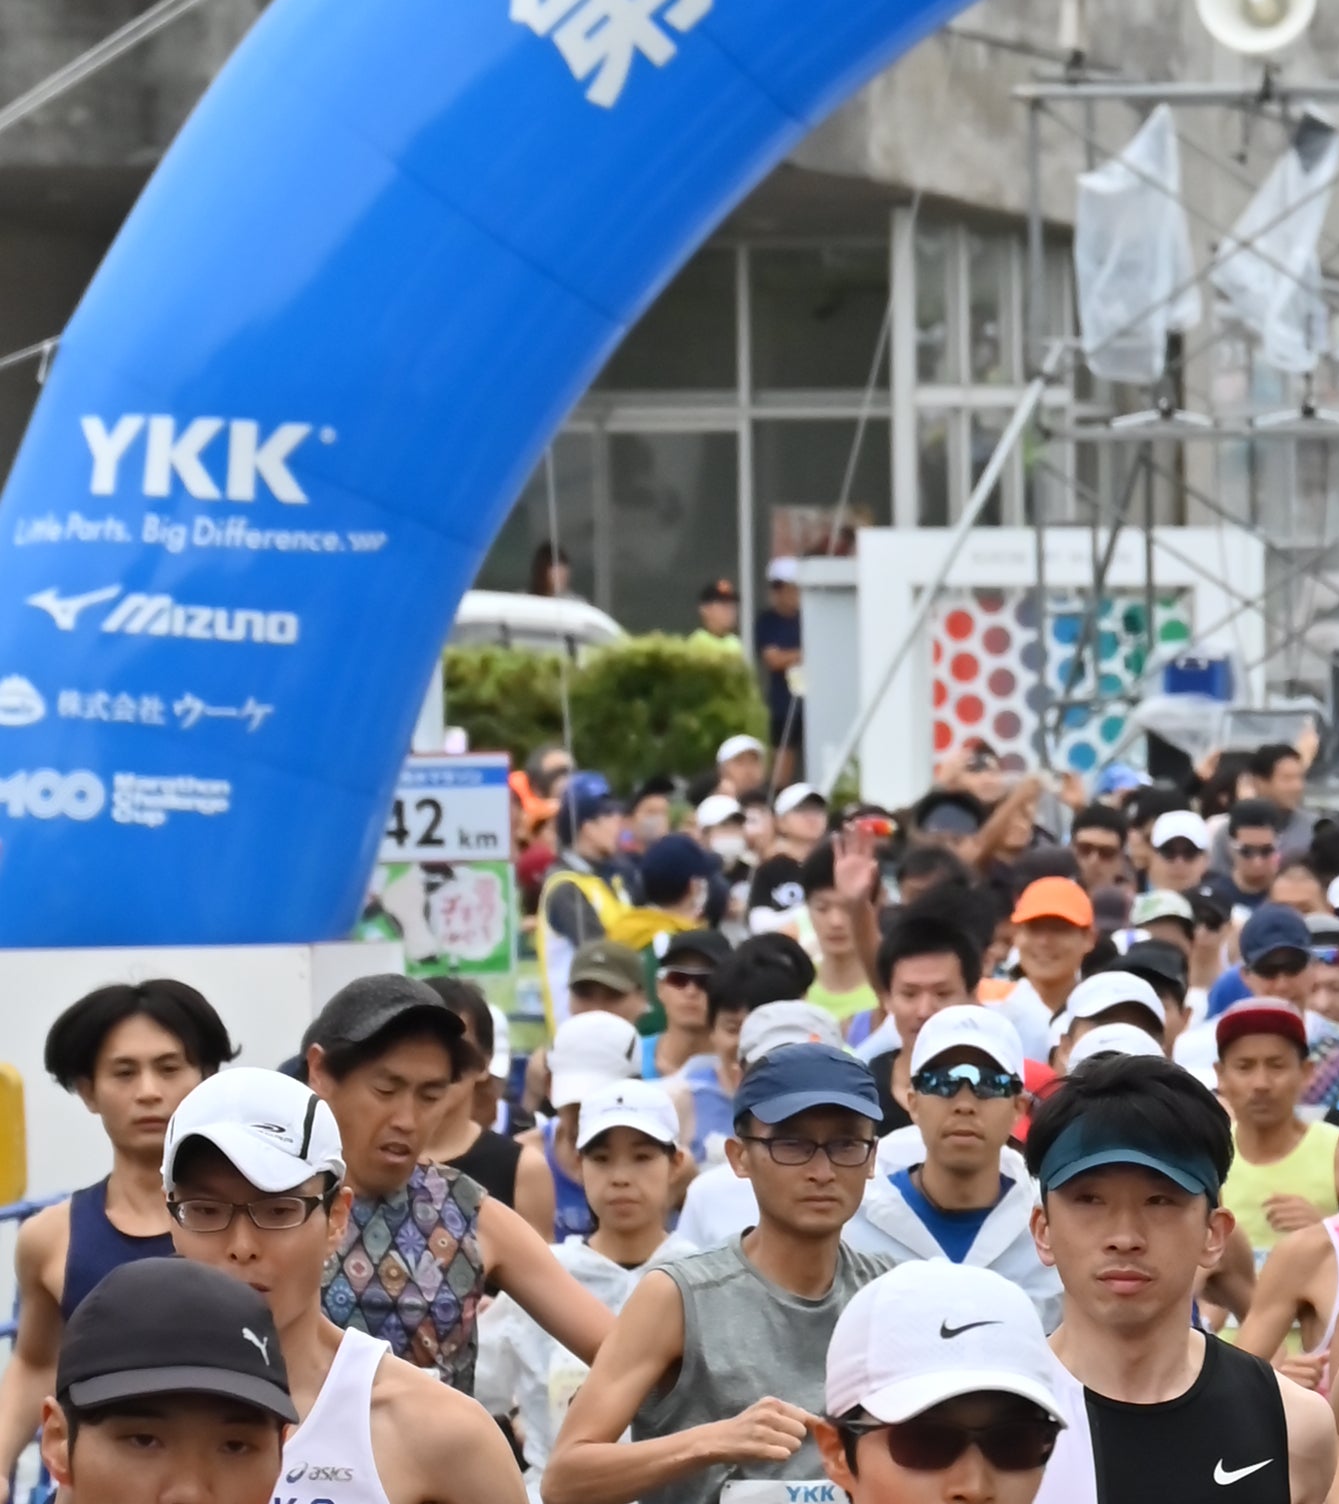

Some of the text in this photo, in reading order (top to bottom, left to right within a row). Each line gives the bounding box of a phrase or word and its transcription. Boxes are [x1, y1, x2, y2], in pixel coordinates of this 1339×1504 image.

[80, 413, 313, 504] YKK
[13, 510, 346, 554] Little Parts. Big Difference.
[457, 828, 499, 849] km
[307, 1466, 354, 1483] asics
[785, 1484, 837, 1504] YKK
